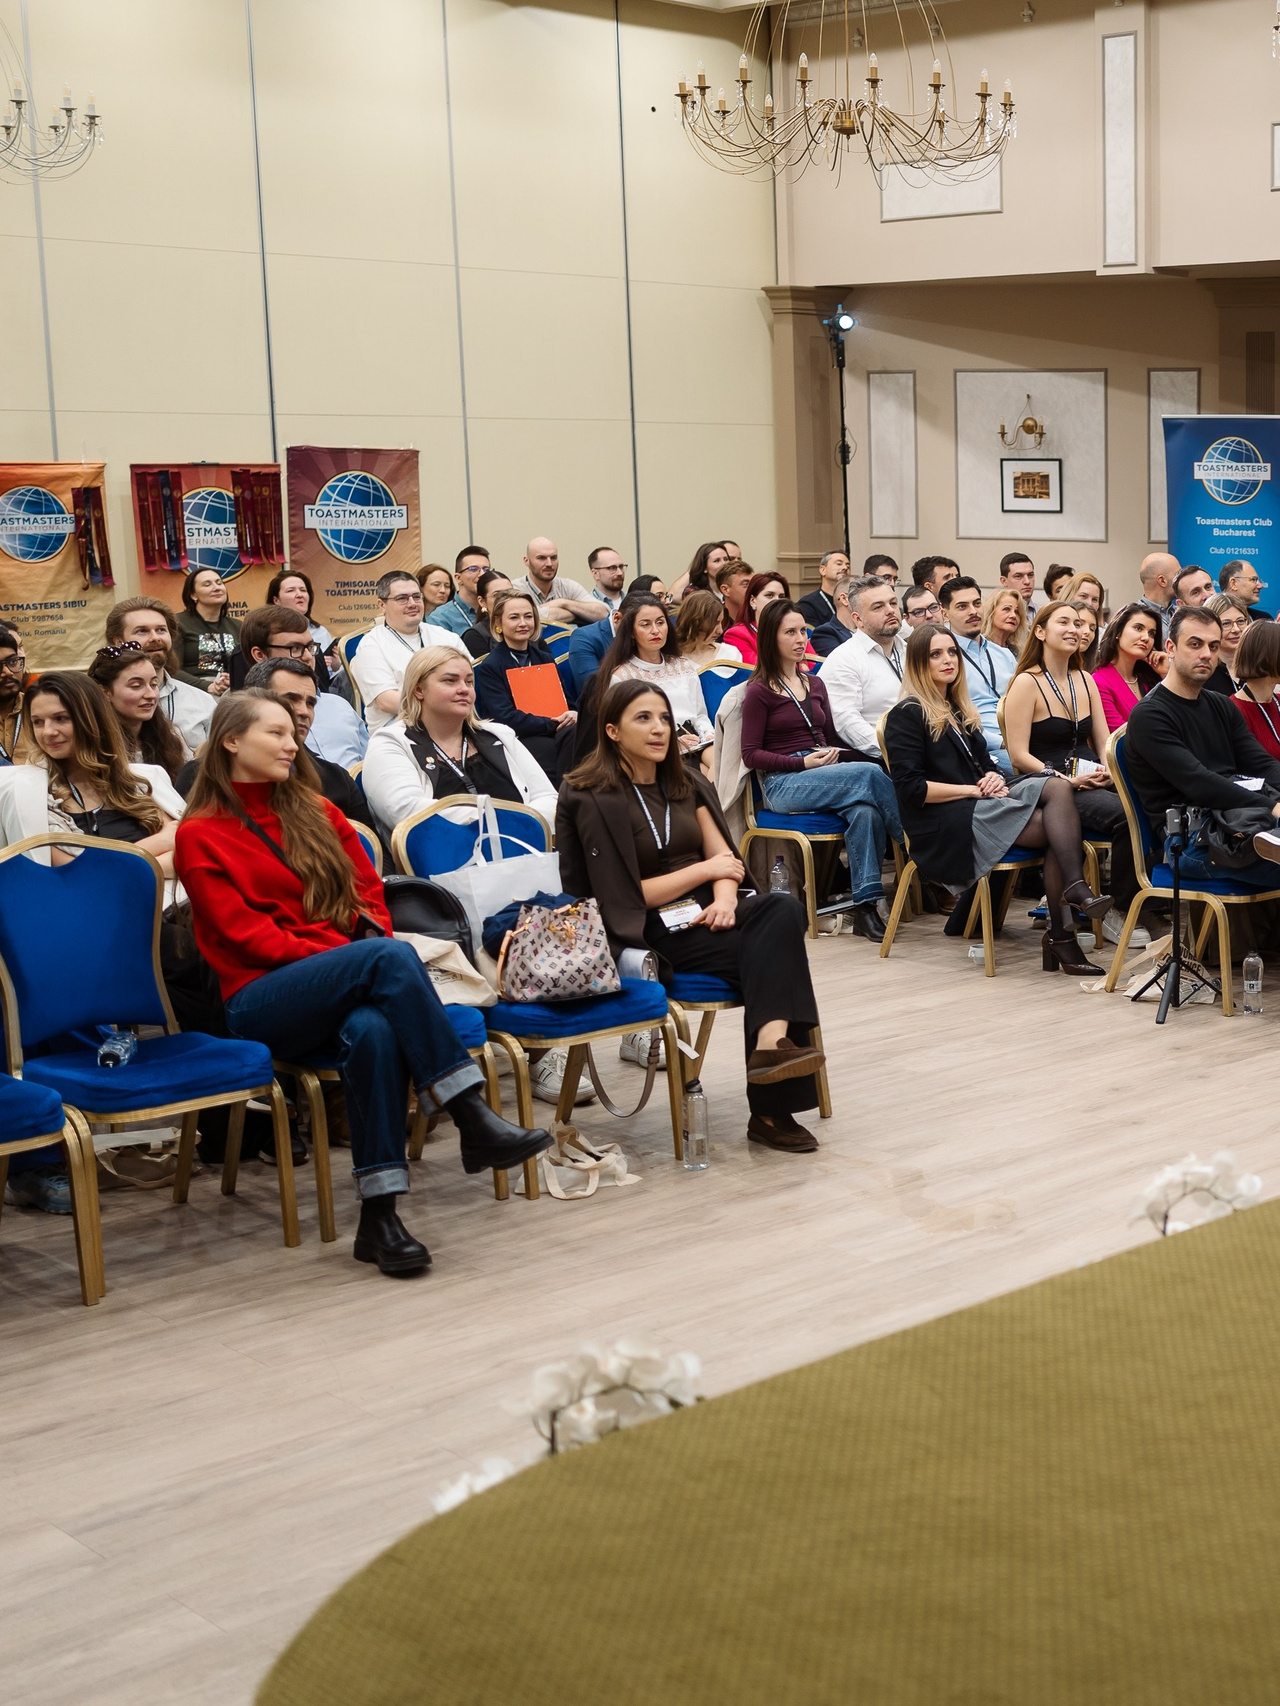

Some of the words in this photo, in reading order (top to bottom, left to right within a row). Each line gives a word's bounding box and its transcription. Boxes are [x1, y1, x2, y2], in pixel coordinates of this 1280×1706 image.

[1197, 464, 1268, 473] TOASTMASTERS
[308, 508, 404, 518] TOASTMASTERS
[0, 516, 75, 526] ASTMASTERS
[1195, 516, 1251, 526] Toastmasters
[1253, 517, 1273, 527] Club
[0, 525, 66, 533] NTERNATIONAL
[187, 527, 238, 537] STMAST
[1213, 527, 1256, 537] Bucharest
[188, 538, 238, 546] ERNATION
[1209, 546, 1225, 554] Club
[325, 589, 378, 597] TOASTMAST
[0, 602, 61, 611] ASTMASTERS
[63, 600, 87, 609] SIBIU
[10, 615, 29, 623] Club
[31, 614, 64, 622] 5987658
[34, 628, 67, 636] Romania
